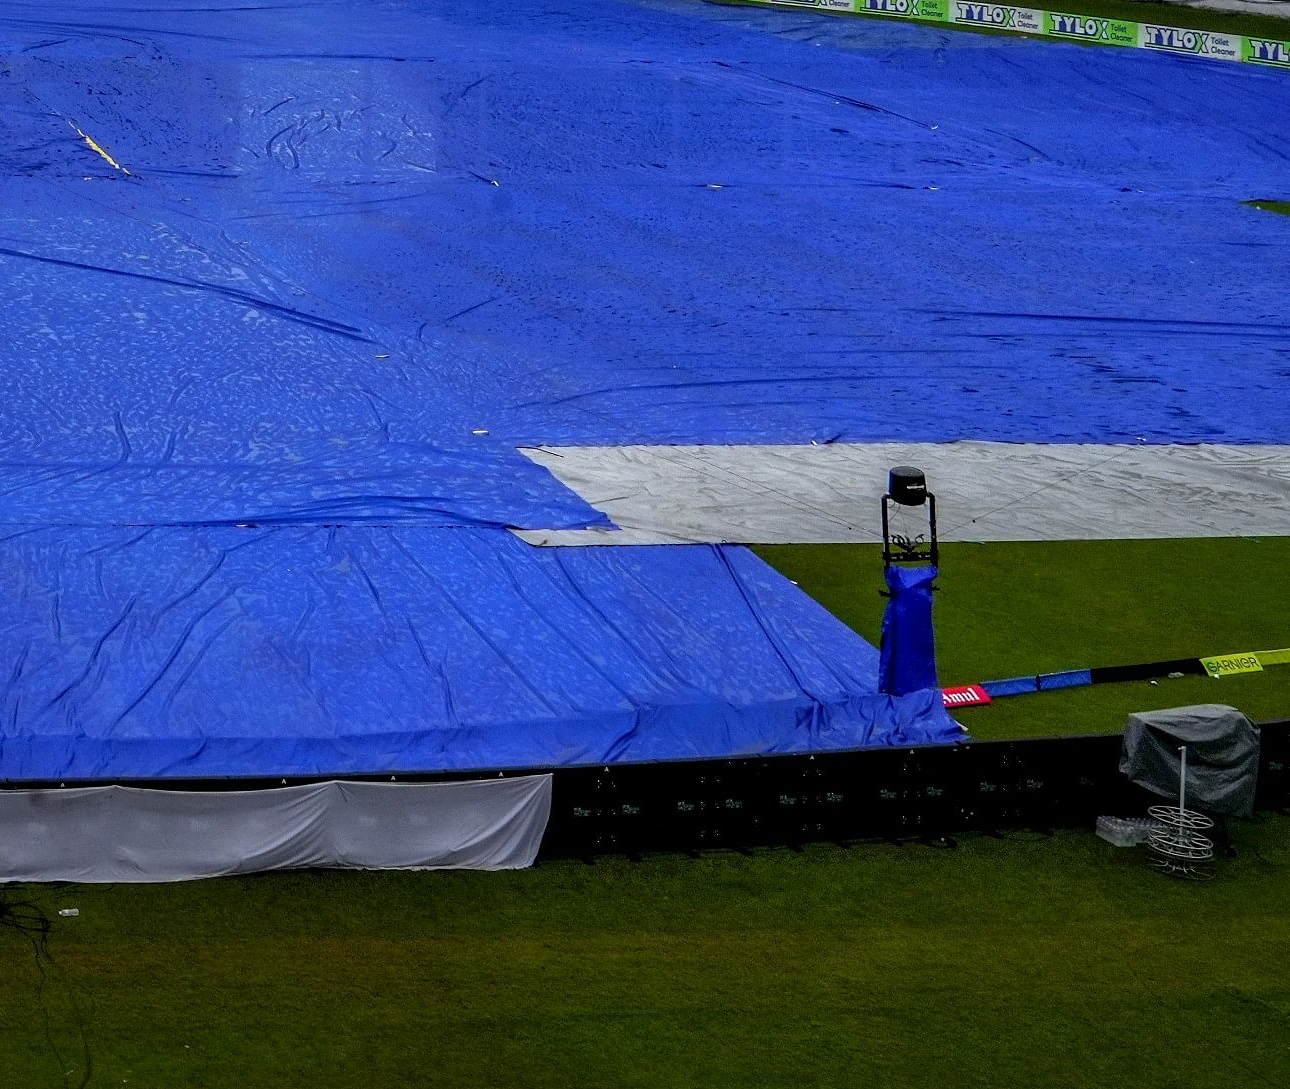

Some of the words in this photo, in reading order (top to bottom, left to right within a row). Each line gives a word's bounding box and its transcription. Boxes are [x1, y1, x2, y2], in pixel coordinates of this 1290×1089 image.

[956, 2, 1016, 28] TYLOX
[1050, 13, 1109, 40] TYLOX
[1146, 26, 1209, 53] TYLOX
[1211, 37, 1229, 47] Toilet
[1211, 46, 1236, 57] Cleaner
[1208, 656, 1259, 673] GARNIER
